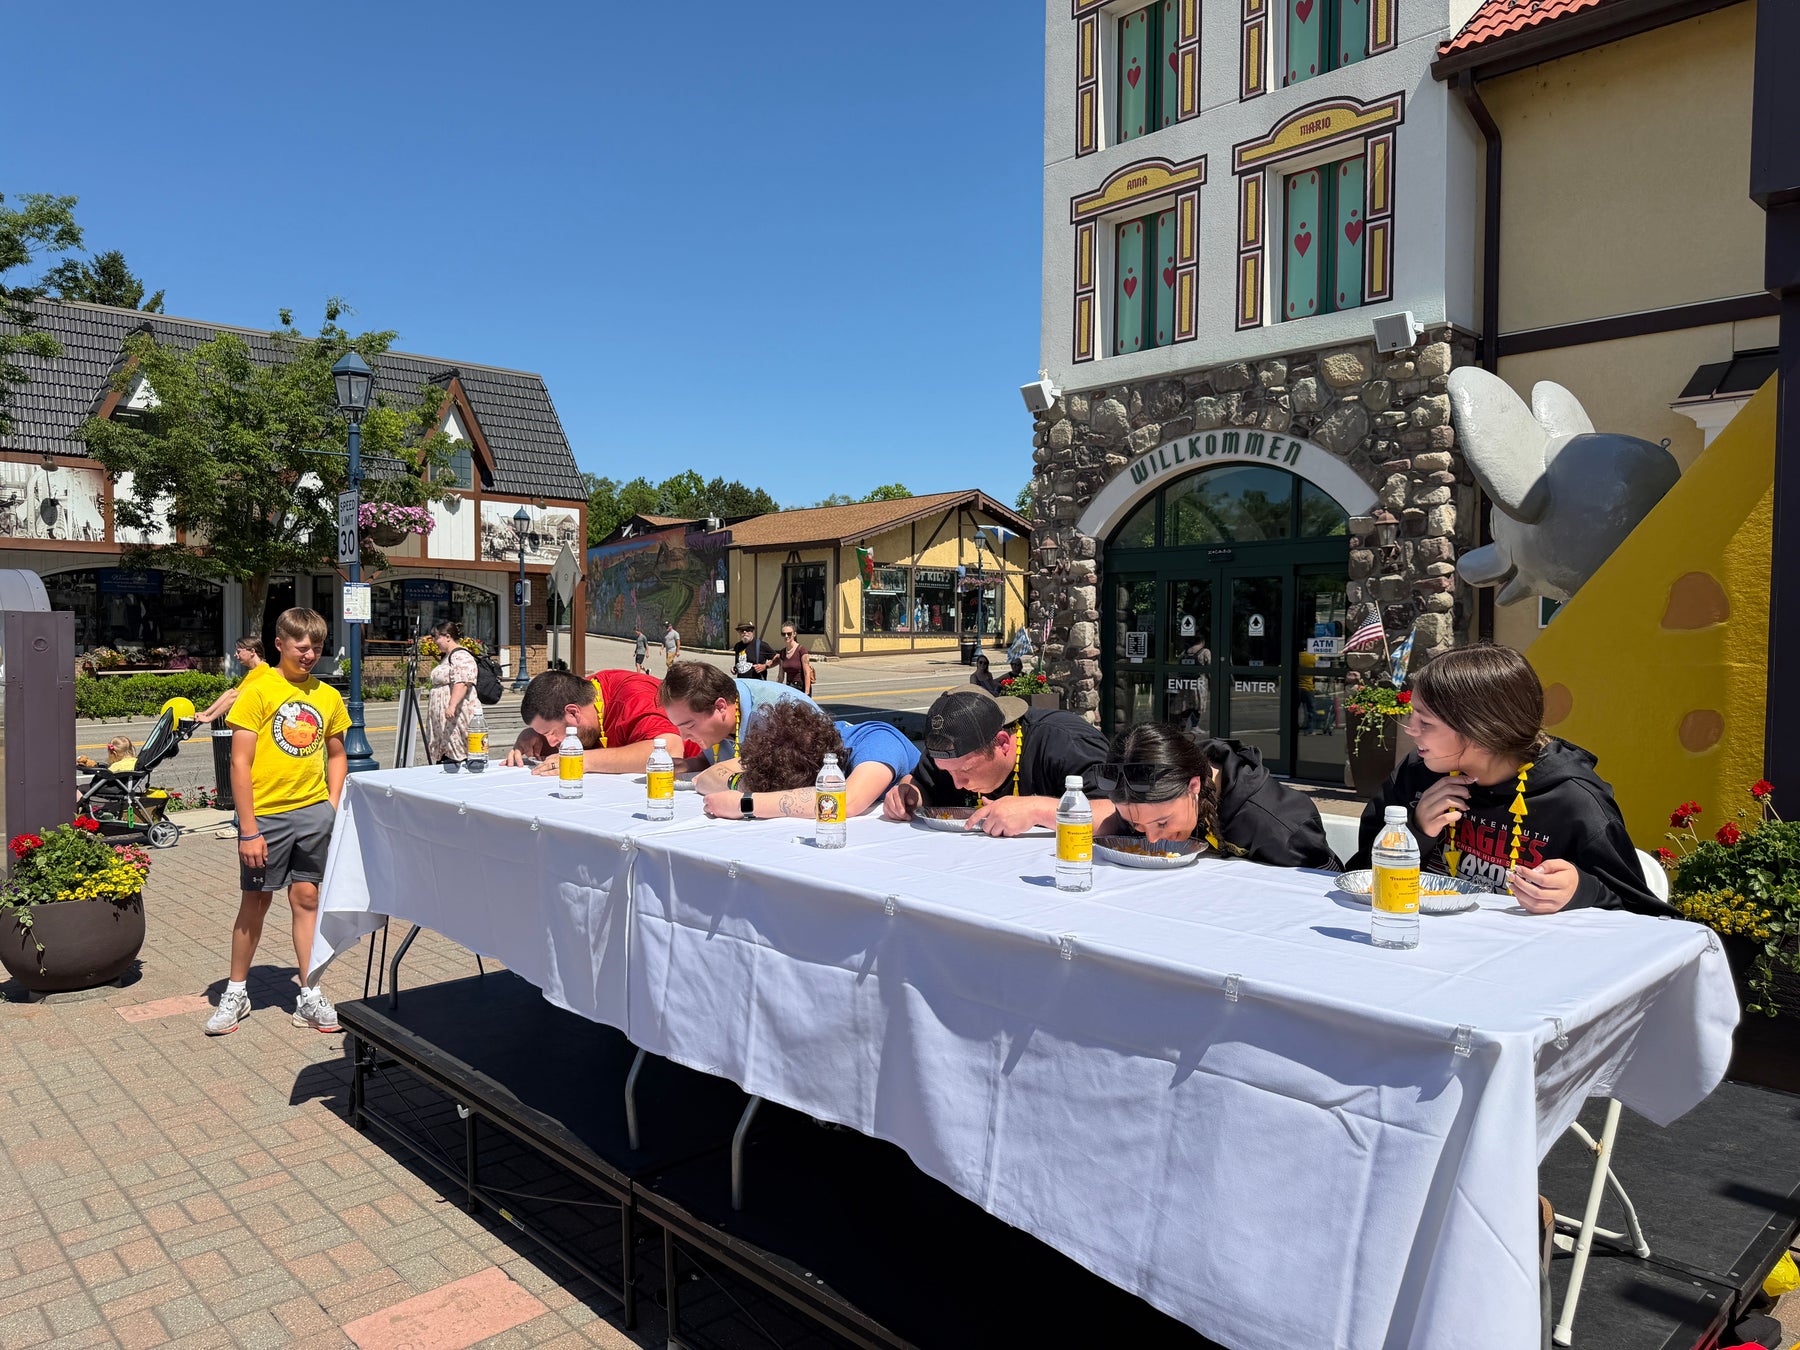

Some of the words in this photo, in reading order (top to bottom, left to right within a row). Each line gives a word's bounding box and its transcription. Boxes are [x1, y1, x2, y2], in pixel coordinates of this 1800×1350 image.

[1299, 116, 1331, 137] MARIO
[1126, 175, 1148, 191] ANNA
[1130, 431, 1302, 485] WILLKOMMEN
[340, 499, 355, 513] SPEED
[341, 514, 354, 527] LIMIT
[340, 529, 355, 556] 30
[915, 570, 925, 581] OT
[927, 571, 951, 583] KILT?
[1168, 679, 1205, 691] ENTER
[1234, 681, 1276, 694] ENTER
[274, 715, 284, 742] CHEESE
[278, 738, 299, 755] HAUS
[1462, 812, 1550, 843] ANKENUTH
[1448, 839, 1481, 857] CHIGAN
[1482, 853, 1502, 865] HIGH
